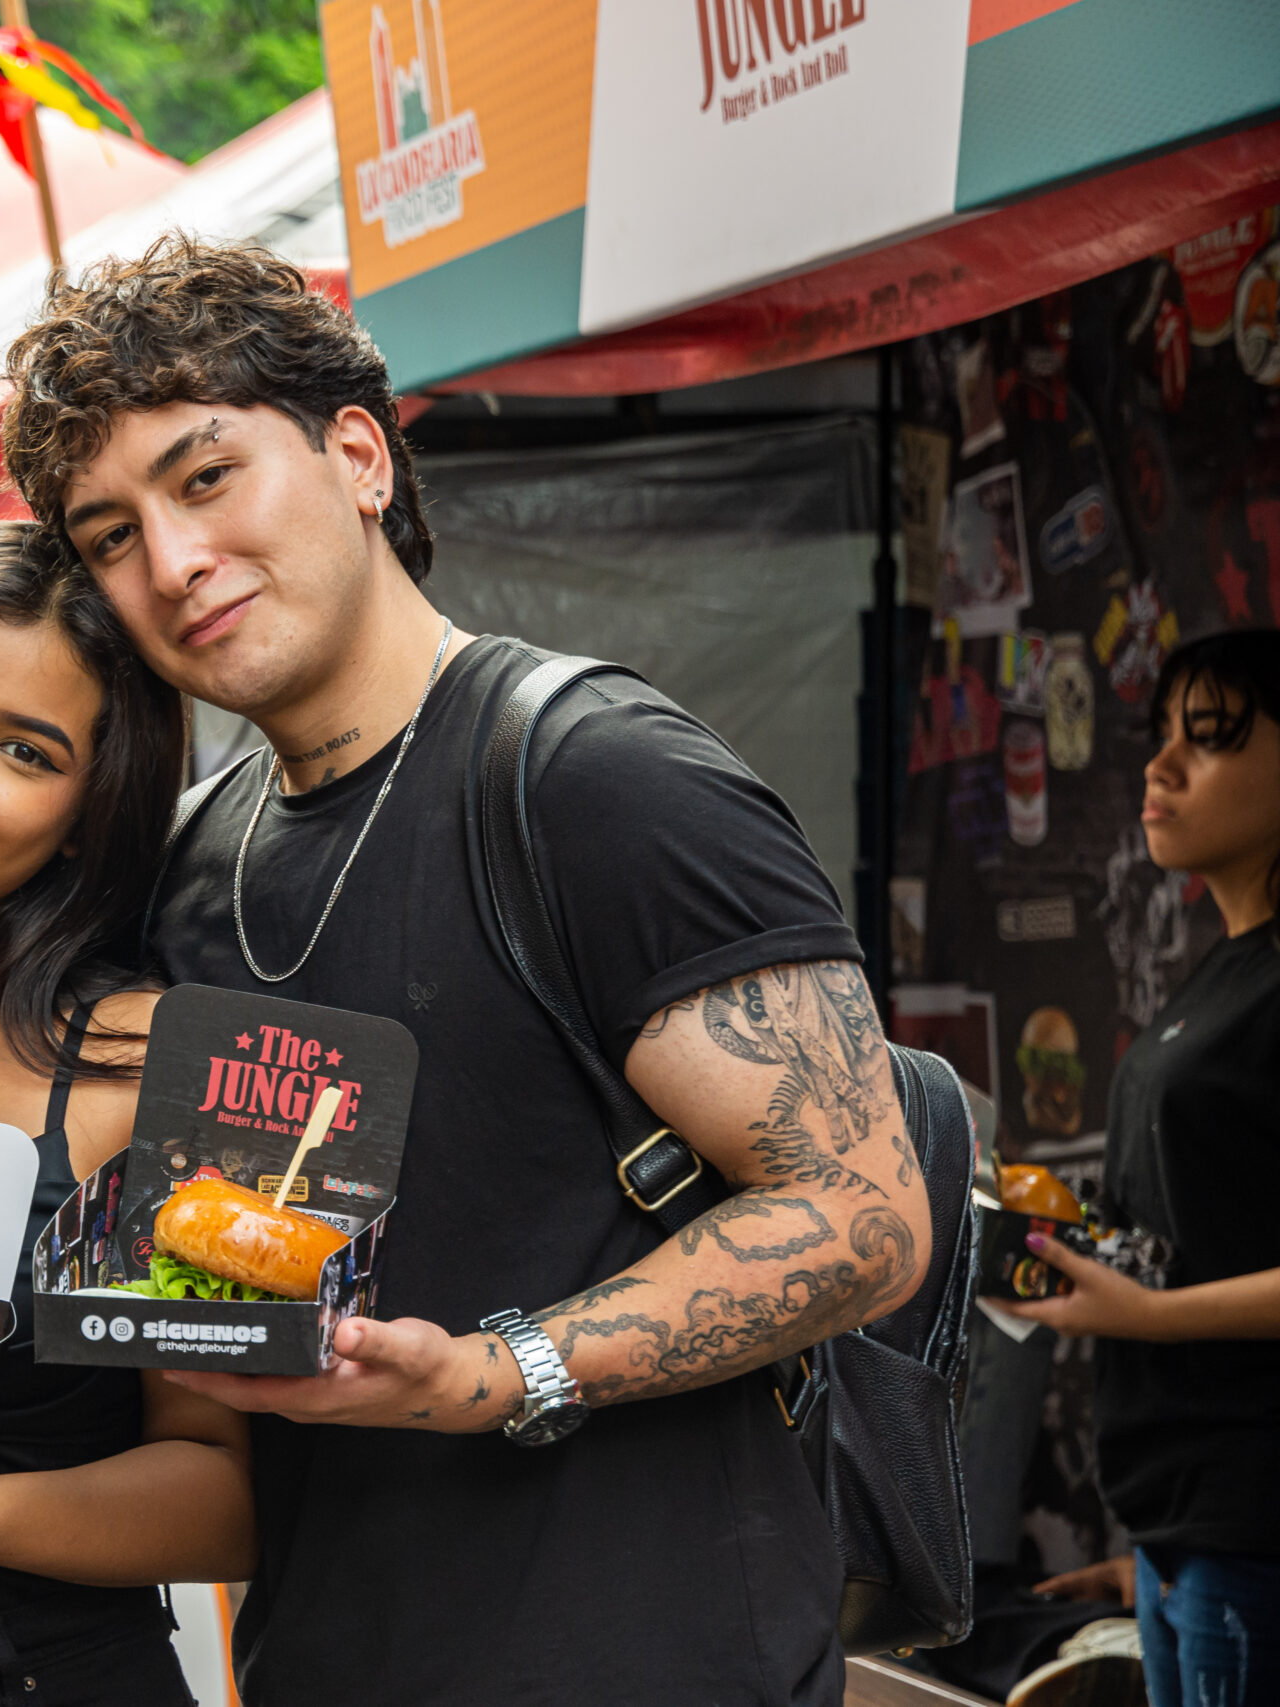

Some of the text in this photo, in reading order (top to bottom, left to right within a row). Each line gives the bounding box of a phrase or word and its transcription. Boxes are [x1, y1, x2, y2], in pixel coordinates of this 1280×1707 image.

[695, 0, 866, 112] JUN
[721, 87, 757, 124] Burger
[770, 67, 798, 103] Rock
[800, 56, 823, 89] And
[824, 43, 849, 80] Roll
[380, 119, 484, 201] CANDELARIA
[303, 746, 326, 761] THE
[325, 728, 361, 753] BOATS
[258, 1025, 322, 1071] The
[217, 1111, 252, 1128] Burger
[254, 1118, 263, 1129] &
[265, 1120, 290, 1135] Rock
[142, 1319, 267, 1343] SÍGUENOS
[157, 1340, 248, 1355] @thejungleburger
